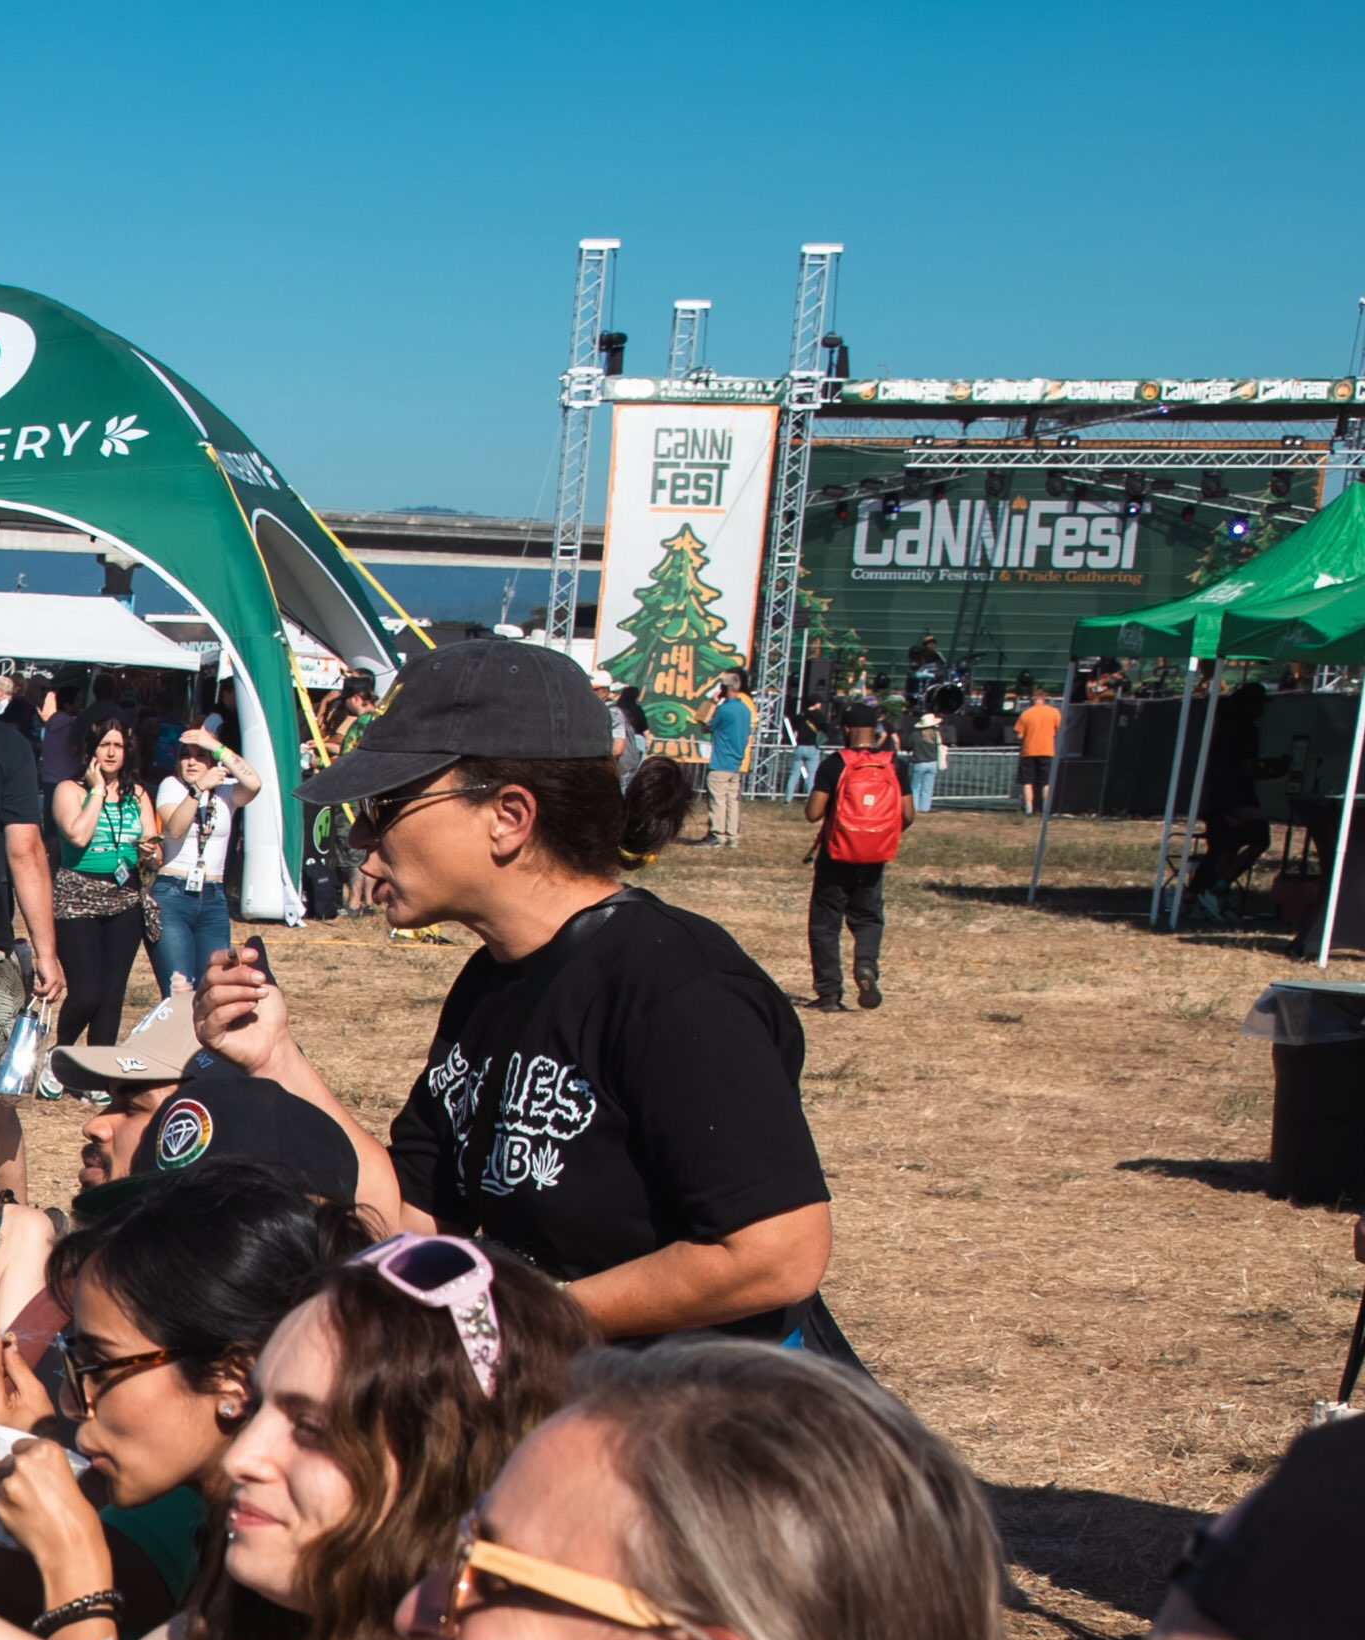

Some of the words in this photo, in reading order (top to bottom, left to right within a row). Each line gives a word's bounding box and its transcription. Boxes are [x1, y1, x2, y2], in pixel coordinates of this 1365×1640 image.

[851, 567, 933, 583] Community
[939, 569, 995, 582] Festval
[999, 570, 1011, 582] &
[1016, 570, 1062, 583] Trade
[1066, 571, 1143, 585] Gathering
